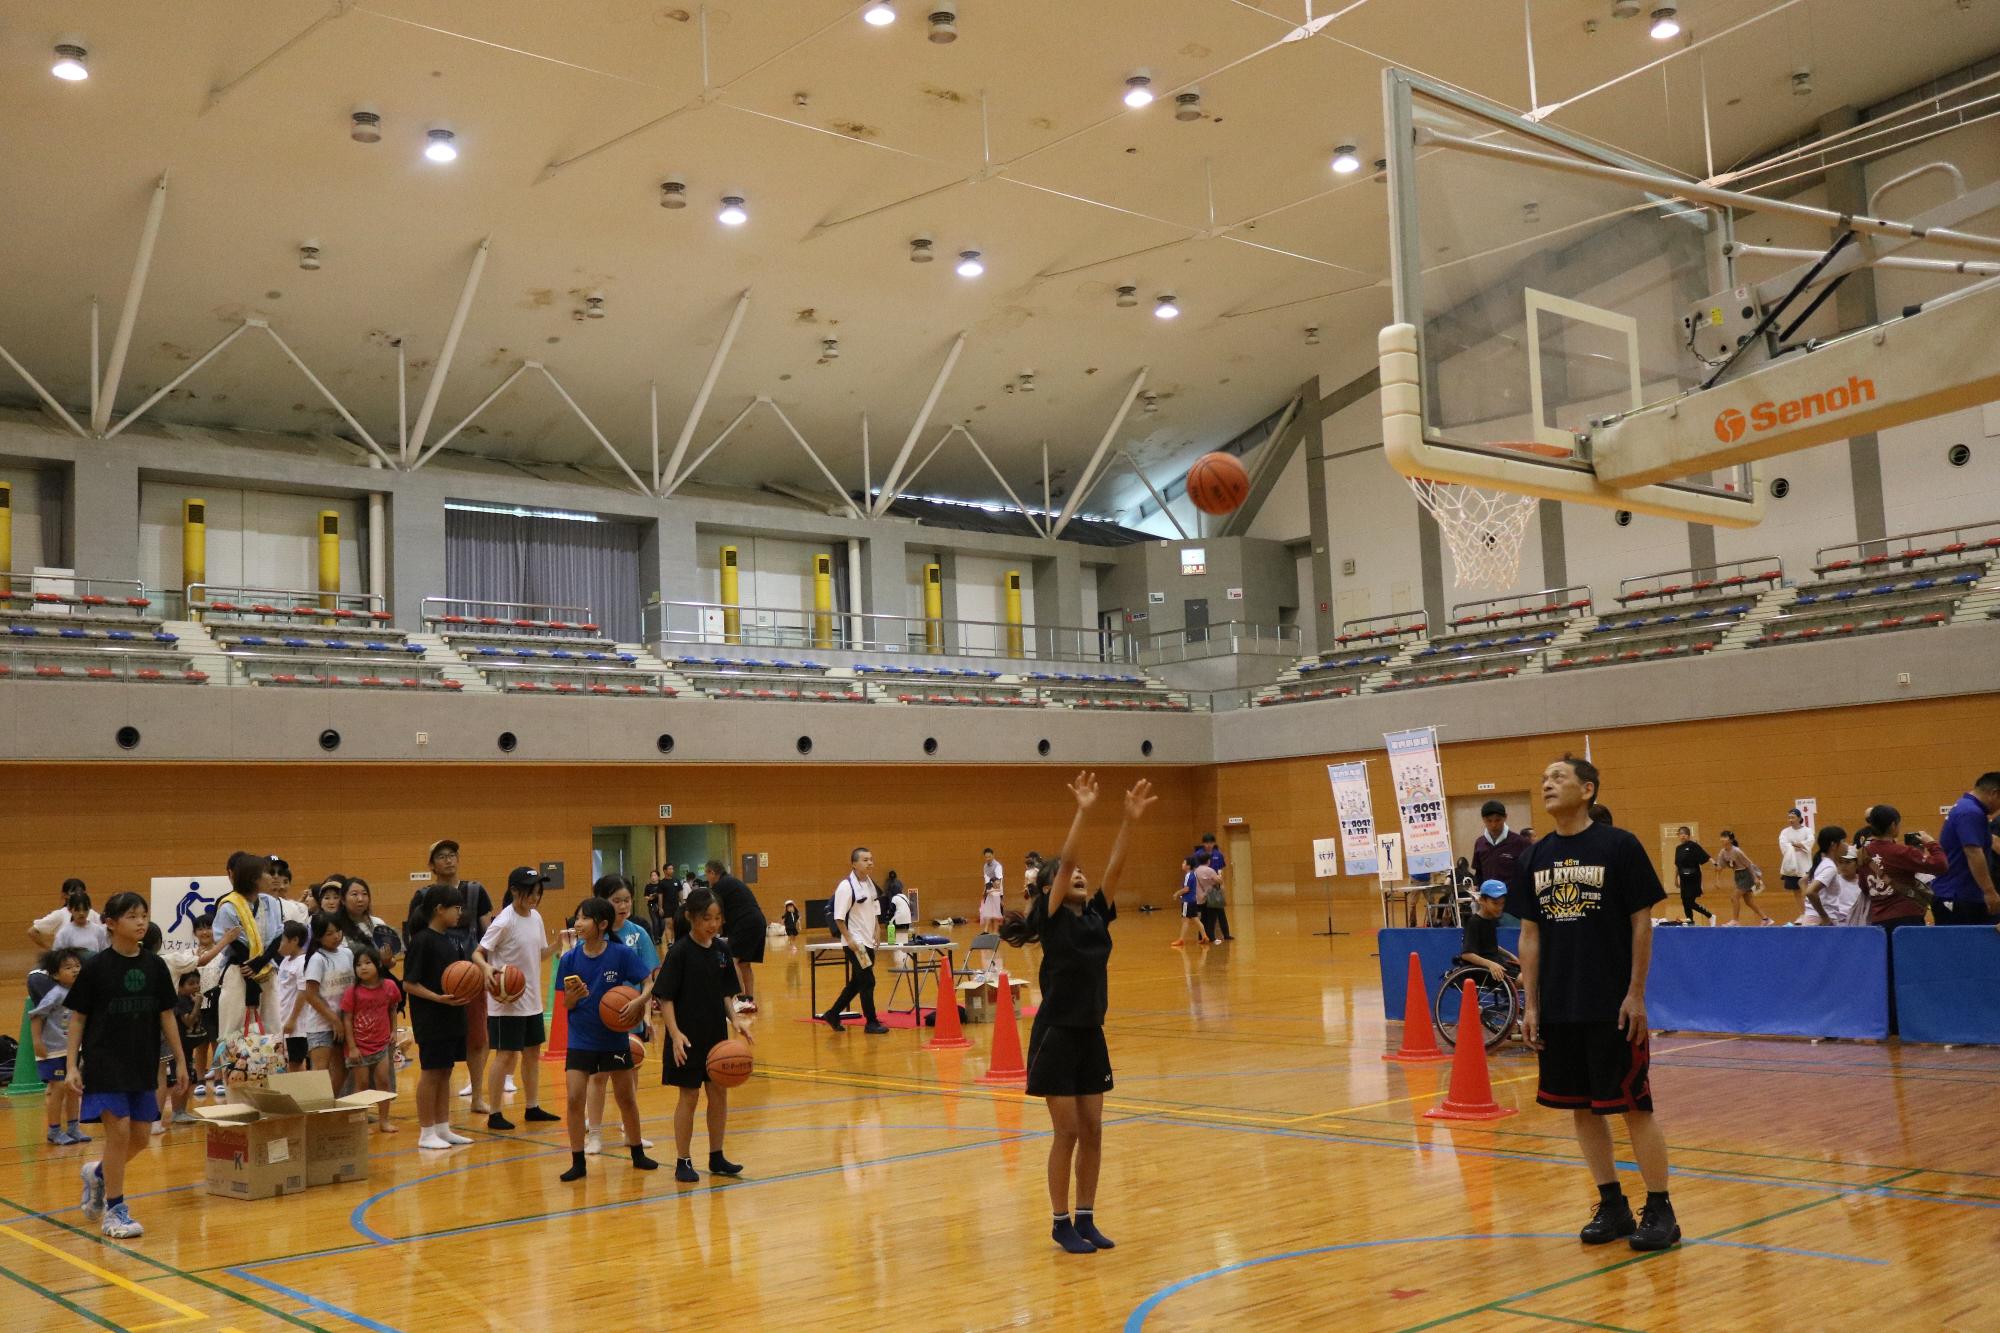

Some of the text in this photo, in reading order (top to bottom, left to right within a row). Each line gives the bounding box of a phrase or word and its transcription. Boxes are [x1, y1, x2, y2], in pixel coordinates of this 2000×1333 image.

[1750, 376, 1876, 432] Senoh
[1534, 866, 1605, 895] ALL KYUSHU
